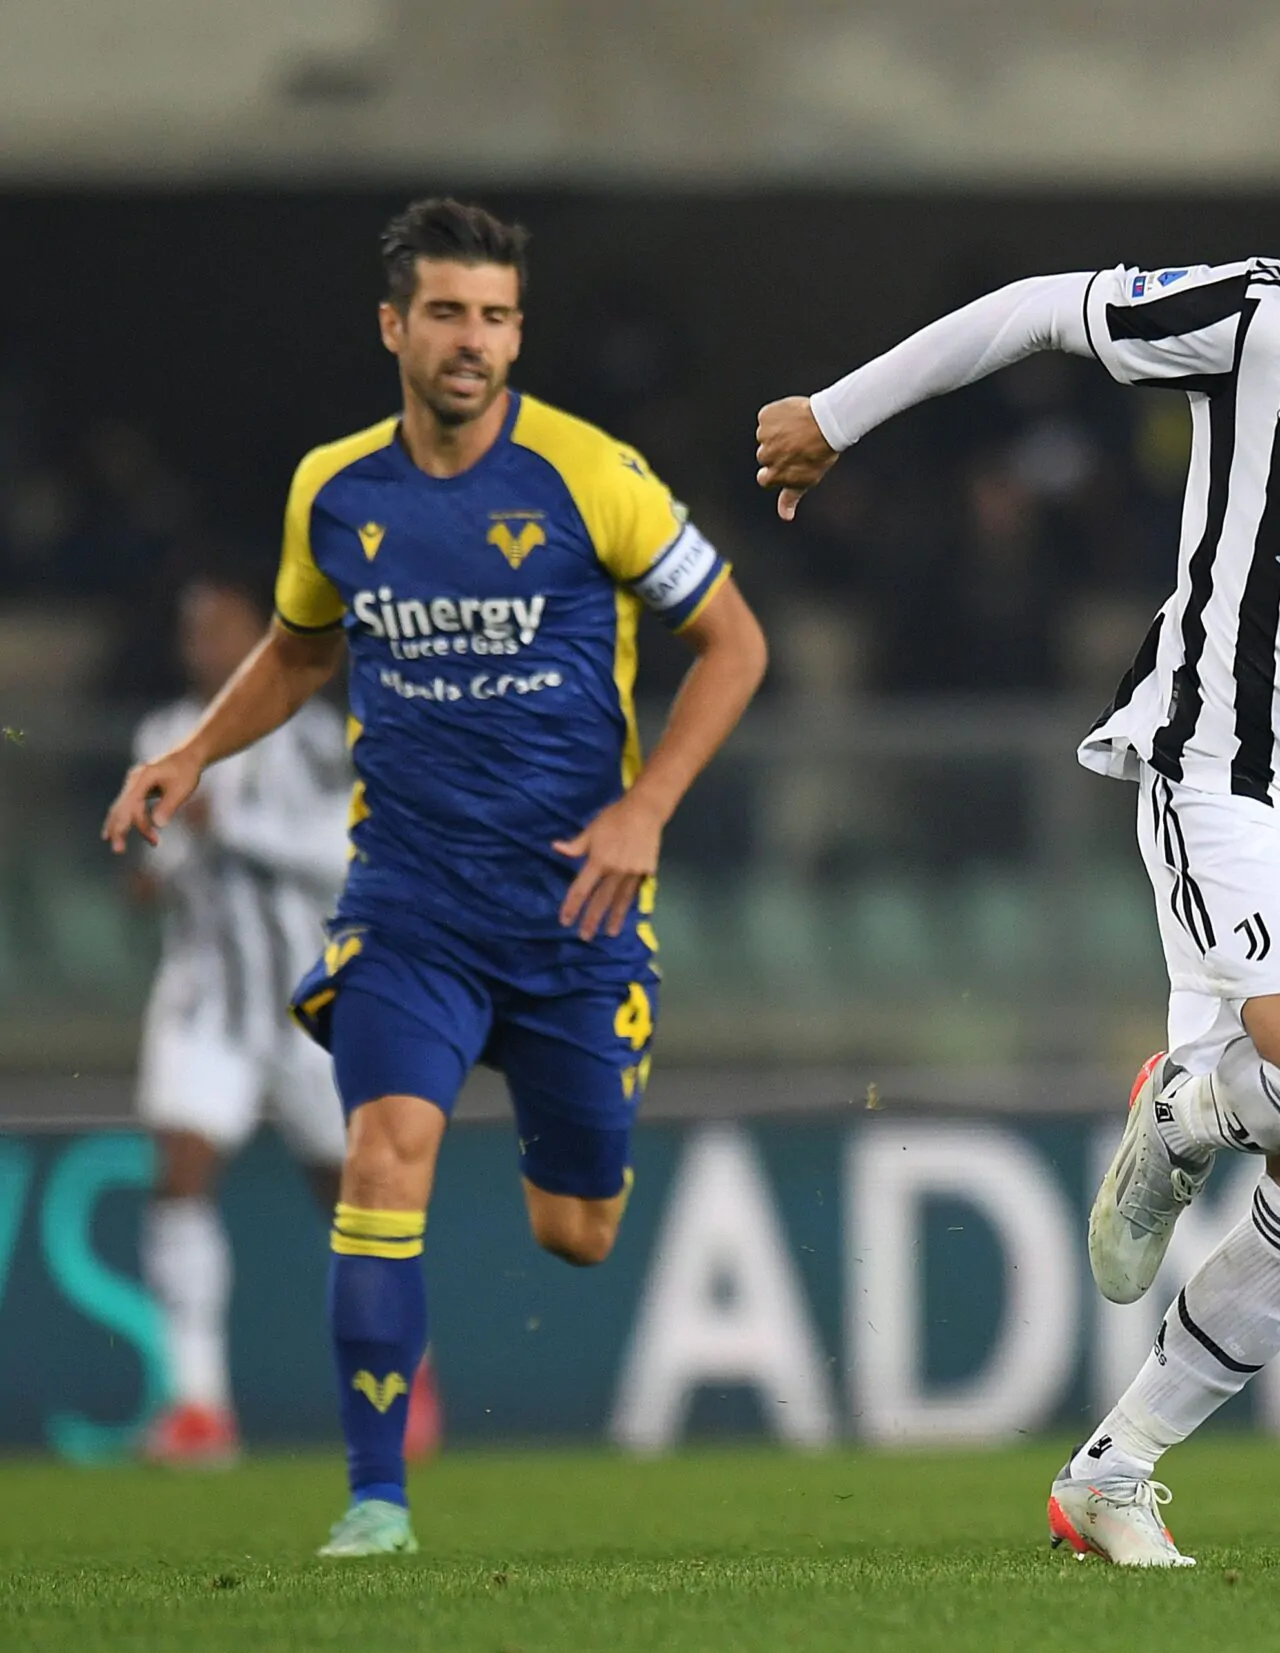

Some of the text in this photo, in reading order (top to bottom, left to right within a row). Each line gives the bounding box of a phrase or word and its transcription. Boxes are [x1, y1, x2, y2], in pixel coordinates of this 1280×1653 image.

[644, 537, 706, 602] CAPITA
[353, 585, 546, 645] Sinergy
[390, 634, 520, 660] Luce e Gas
[613, 981, 653, 1050] 4
